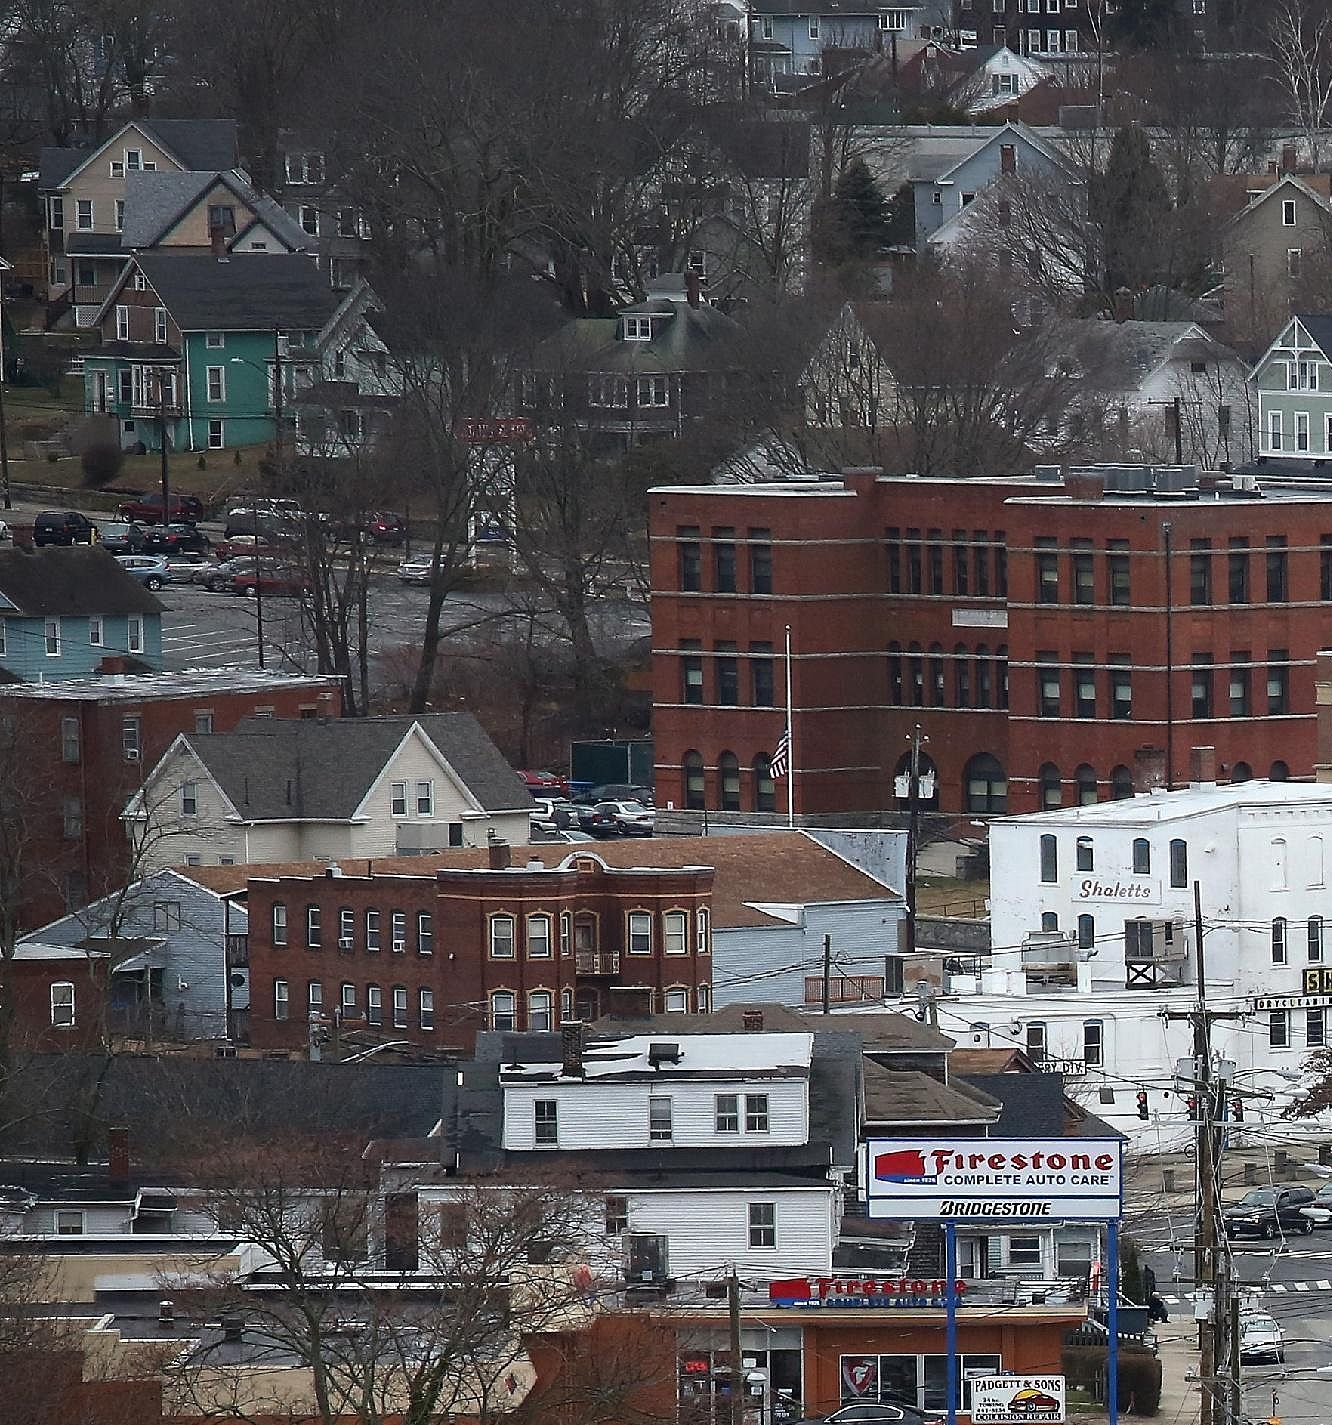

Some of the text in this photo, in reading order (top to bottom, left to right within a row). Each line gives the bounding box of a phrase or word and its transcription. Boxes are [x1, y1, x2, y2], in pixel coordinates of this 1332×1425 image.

[1079, 879, 1151, 898] Shaletts
[930, 1150, 1114, 1176] Firestone
[943, 1174, 1110, 1186] COMPLETE AUTO CARE
[938, 1200, 1052, 1216] BRIDGESTONE
[816, 1278, 968, 1299] Firestone
[975, 1379, 1061, 1392] PADGETT & SONS
